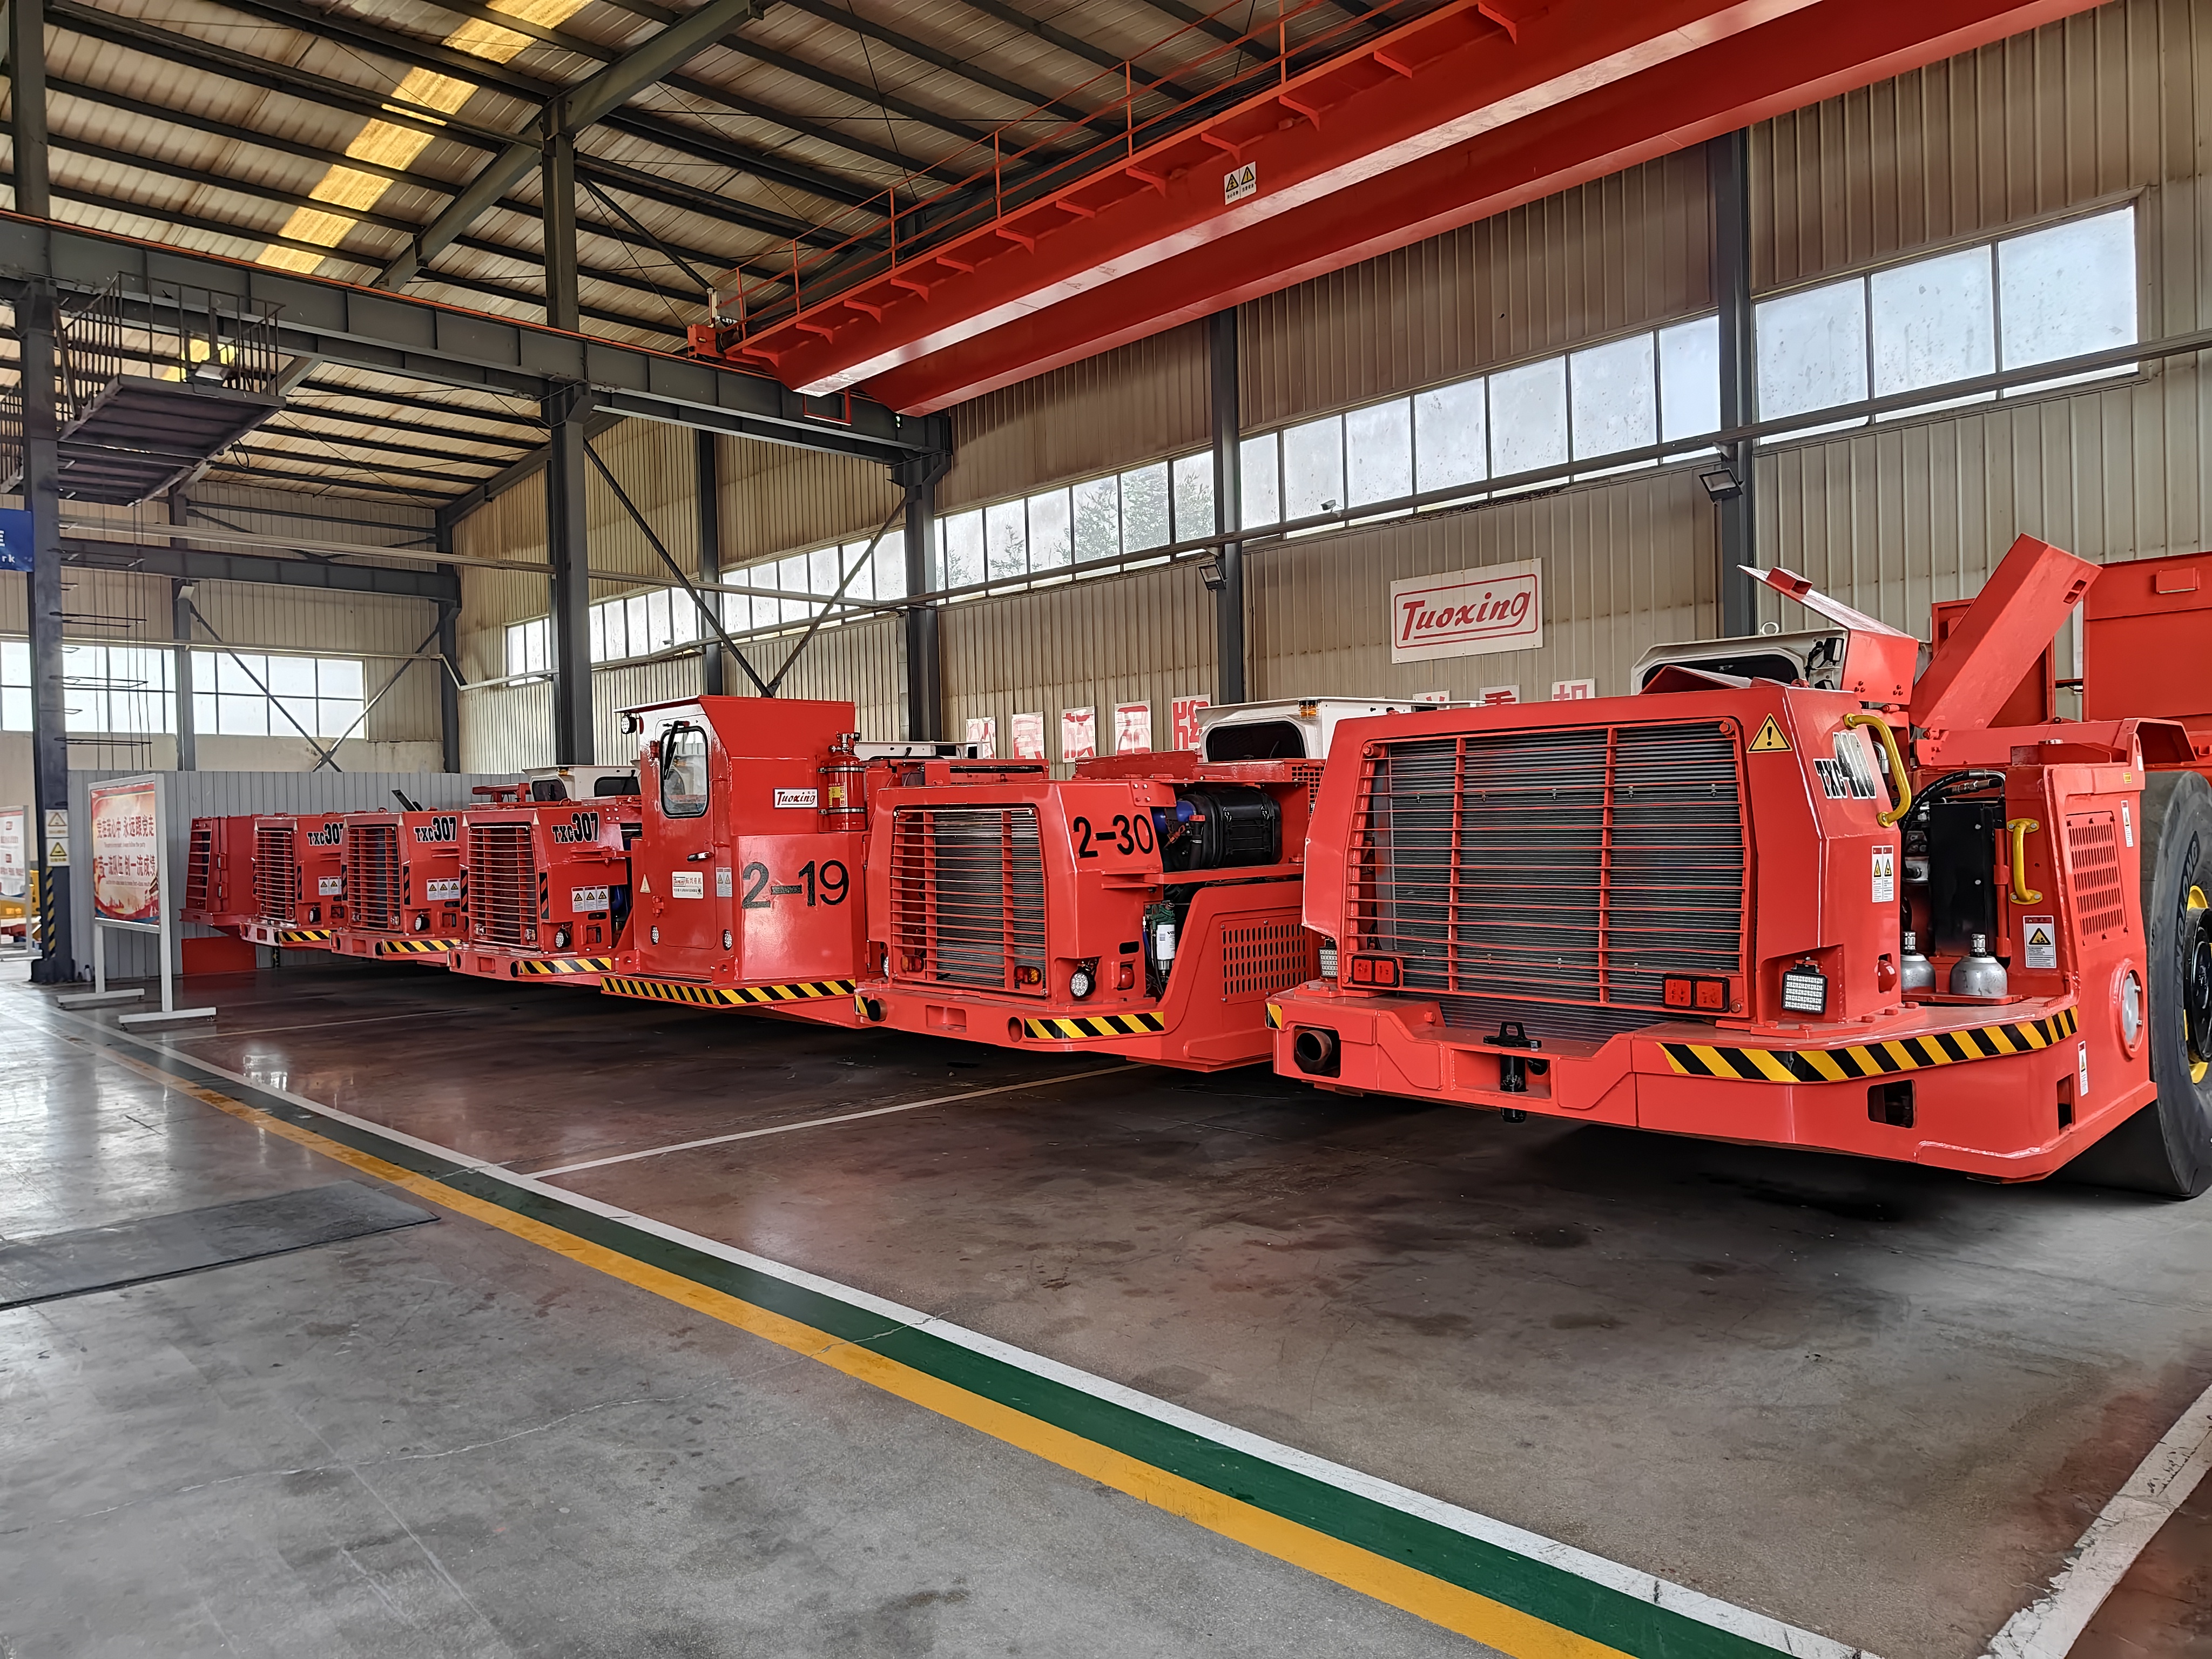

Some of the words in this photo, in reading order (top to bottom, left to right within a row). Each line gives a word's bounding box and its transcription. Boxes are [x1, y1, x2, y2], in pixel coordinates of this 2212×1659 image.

[1401, 591, 1532, 641] Tuoxing
[777, 791, 816, 805] Tuoxing
[414, 816, 457, 842] TXC307
[551, 812, 599, 844] TXC307
[1074, 814, 1154, 858] 2-30
[742, 860, 849, 909] 2-19
